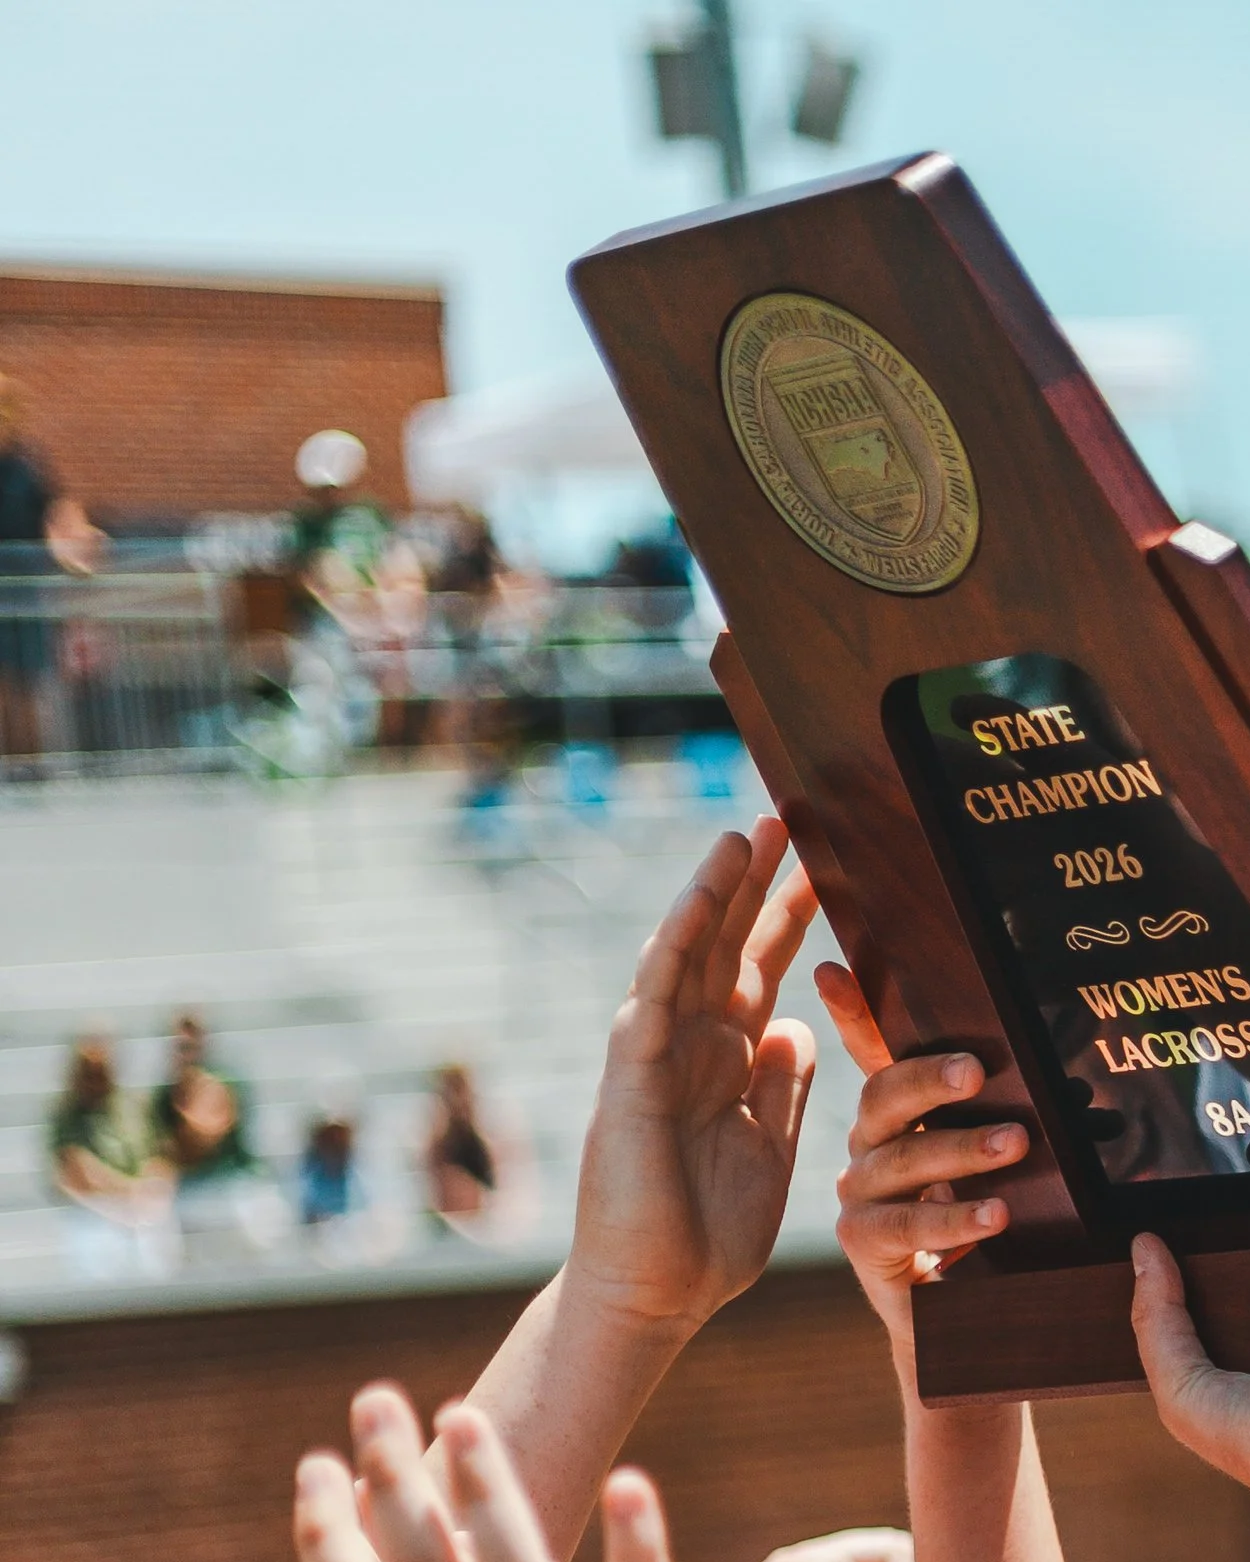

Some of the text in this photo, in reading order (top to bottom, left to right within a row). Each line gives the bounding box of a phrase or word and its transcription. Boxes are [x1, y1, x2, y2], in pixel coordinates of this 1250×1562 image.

[735, 325, 767, 375] HIGH
[754, 306, 818, 342] SCHOOL
[819, 311, 905, 377] ATHLETIC
[733, 367, 782, 480] CAROLINA
[779, 376, 882, 431] NCHSAA
[905, 376, 970, 516] ASSOCIATION
[972, 705, 1085, 756] STATE
[964, 760, 1163, 824] CHAMPION
[1054, 844, 1144, 889] 2026
